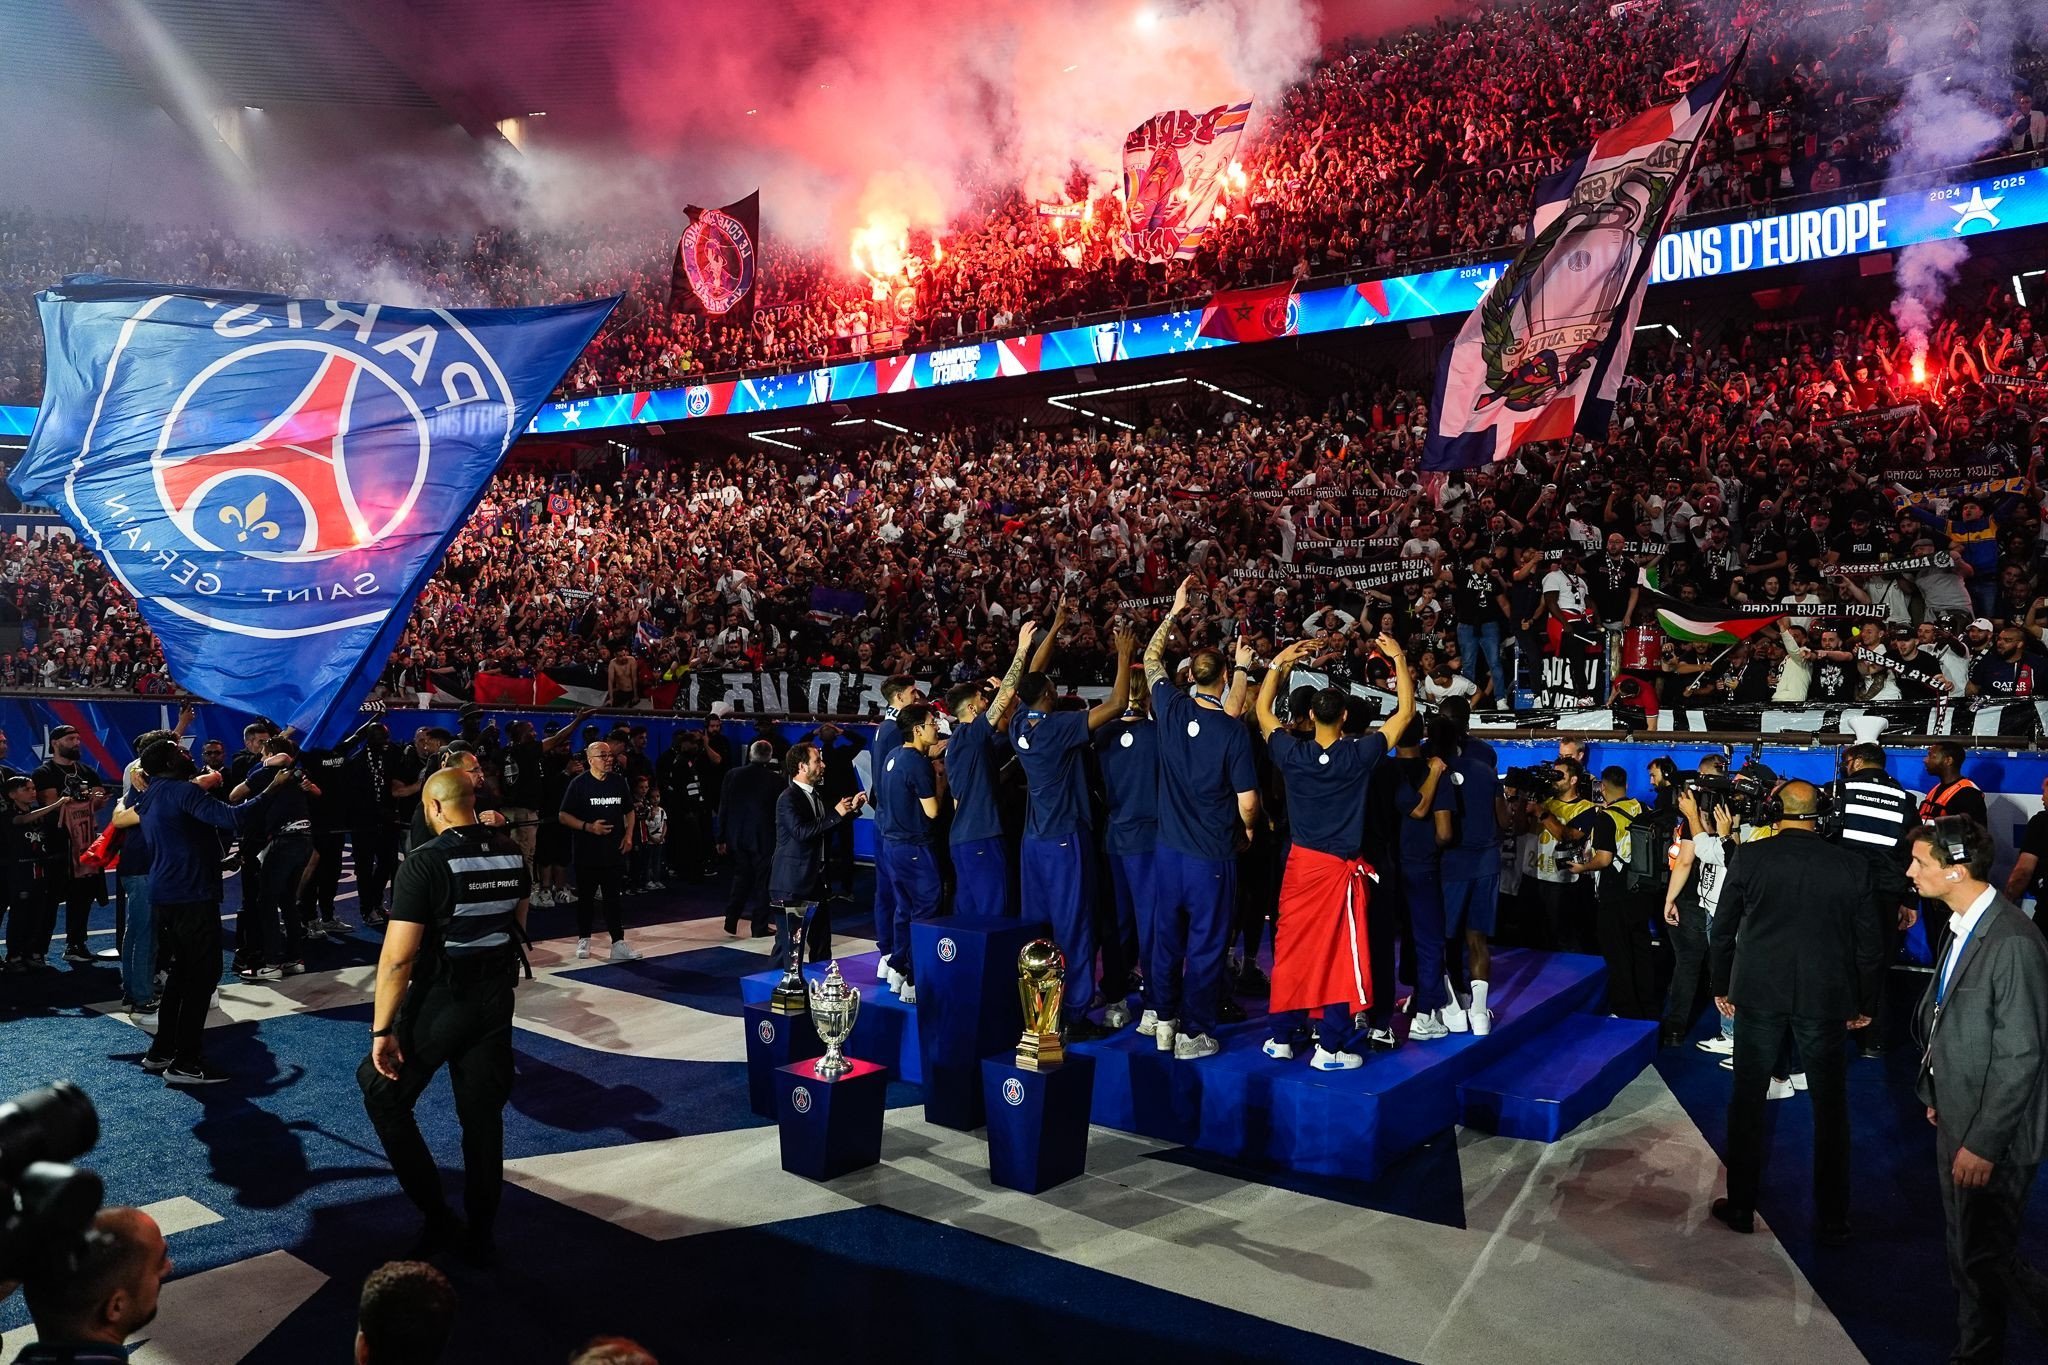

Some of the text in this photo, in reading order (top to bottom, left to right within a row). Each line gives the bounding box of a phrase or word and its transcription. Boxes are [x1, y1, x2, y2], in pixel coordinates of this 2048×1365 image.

[1992, 175, 2027, 191] 2025
[1929, 187, 1961, 202] 2024
[1730, 197, 1888, 272] D'EUROPE
[1460, 268, 1482, 279] 2024
[929, 345, 981, 368] CHAMPIONS
[555, 403, 568, 411] 2024
[1336, 538, 1365, 548] AVEC
[1369, 537, 1400, 547] NOUS
[1853, 543, 1872, 552] POLO
[1370, 561, 1398, 573] AVEC
[1392, 569, 1419, 583] AVEC
[1797, 604, 1839, 616] AVEC
[1845, 603, 1887, 618] NOUS
[468, 879, 519, 891] SÉCURITÉ PRIVÉE
